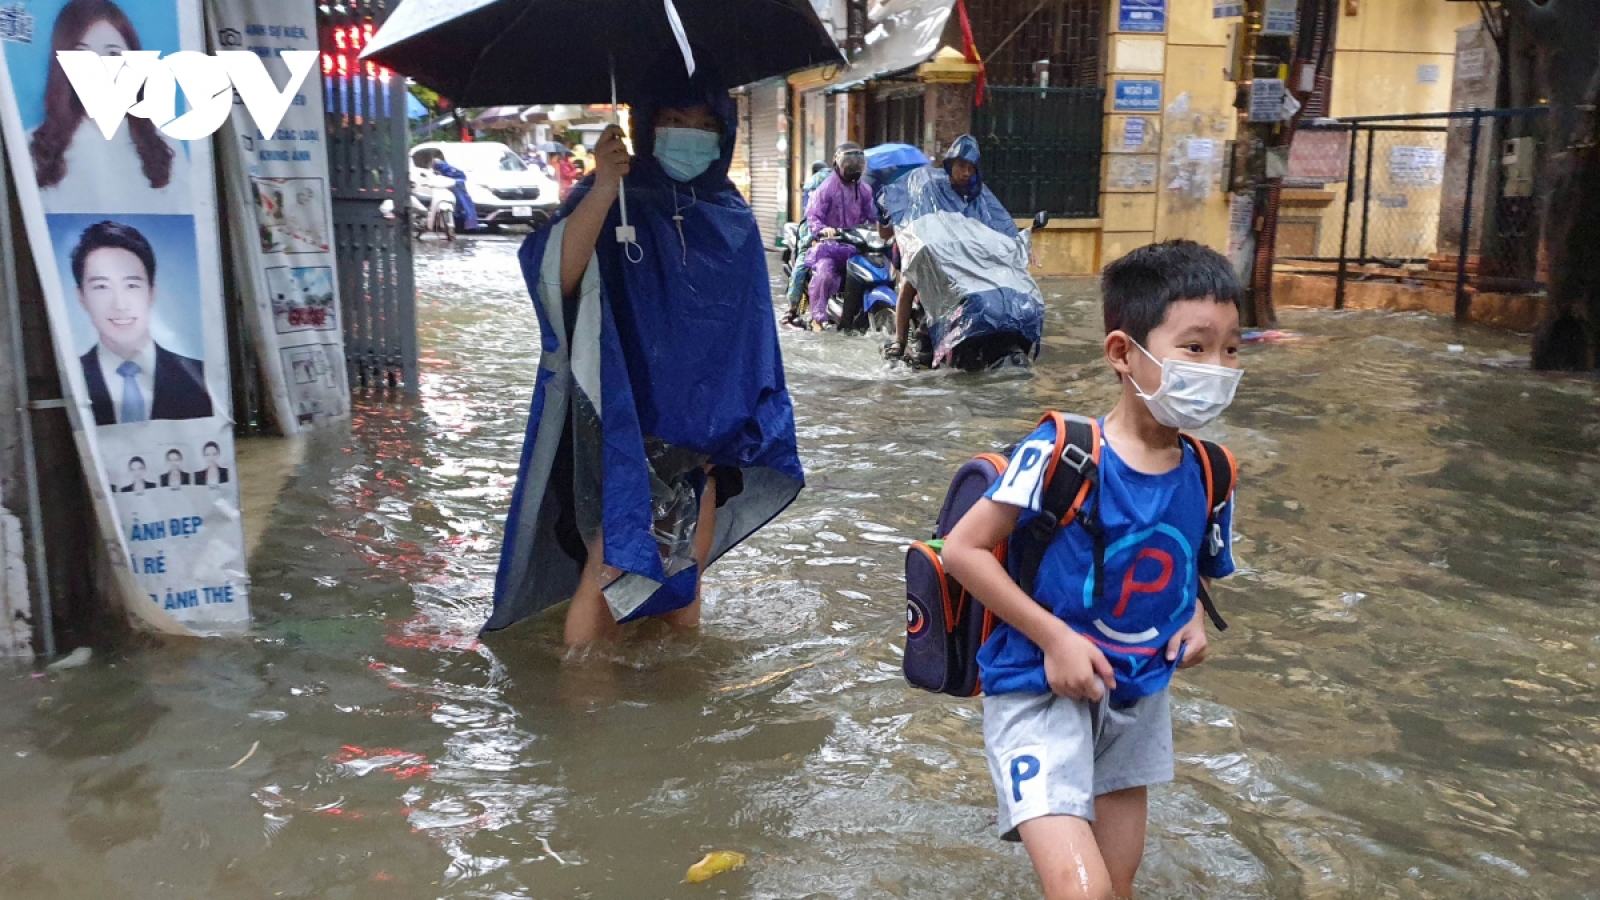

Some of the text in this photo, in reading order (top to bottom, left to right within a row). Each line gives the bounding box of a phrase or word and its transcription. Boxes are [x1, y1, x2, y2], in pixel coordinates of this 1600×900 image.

[1008, 446, 1043, 487] P
[168, 515, 204, 539] ĐẸP
[1112, 547, 1174, 618] P
[1010, 755, 1041, 803] P
